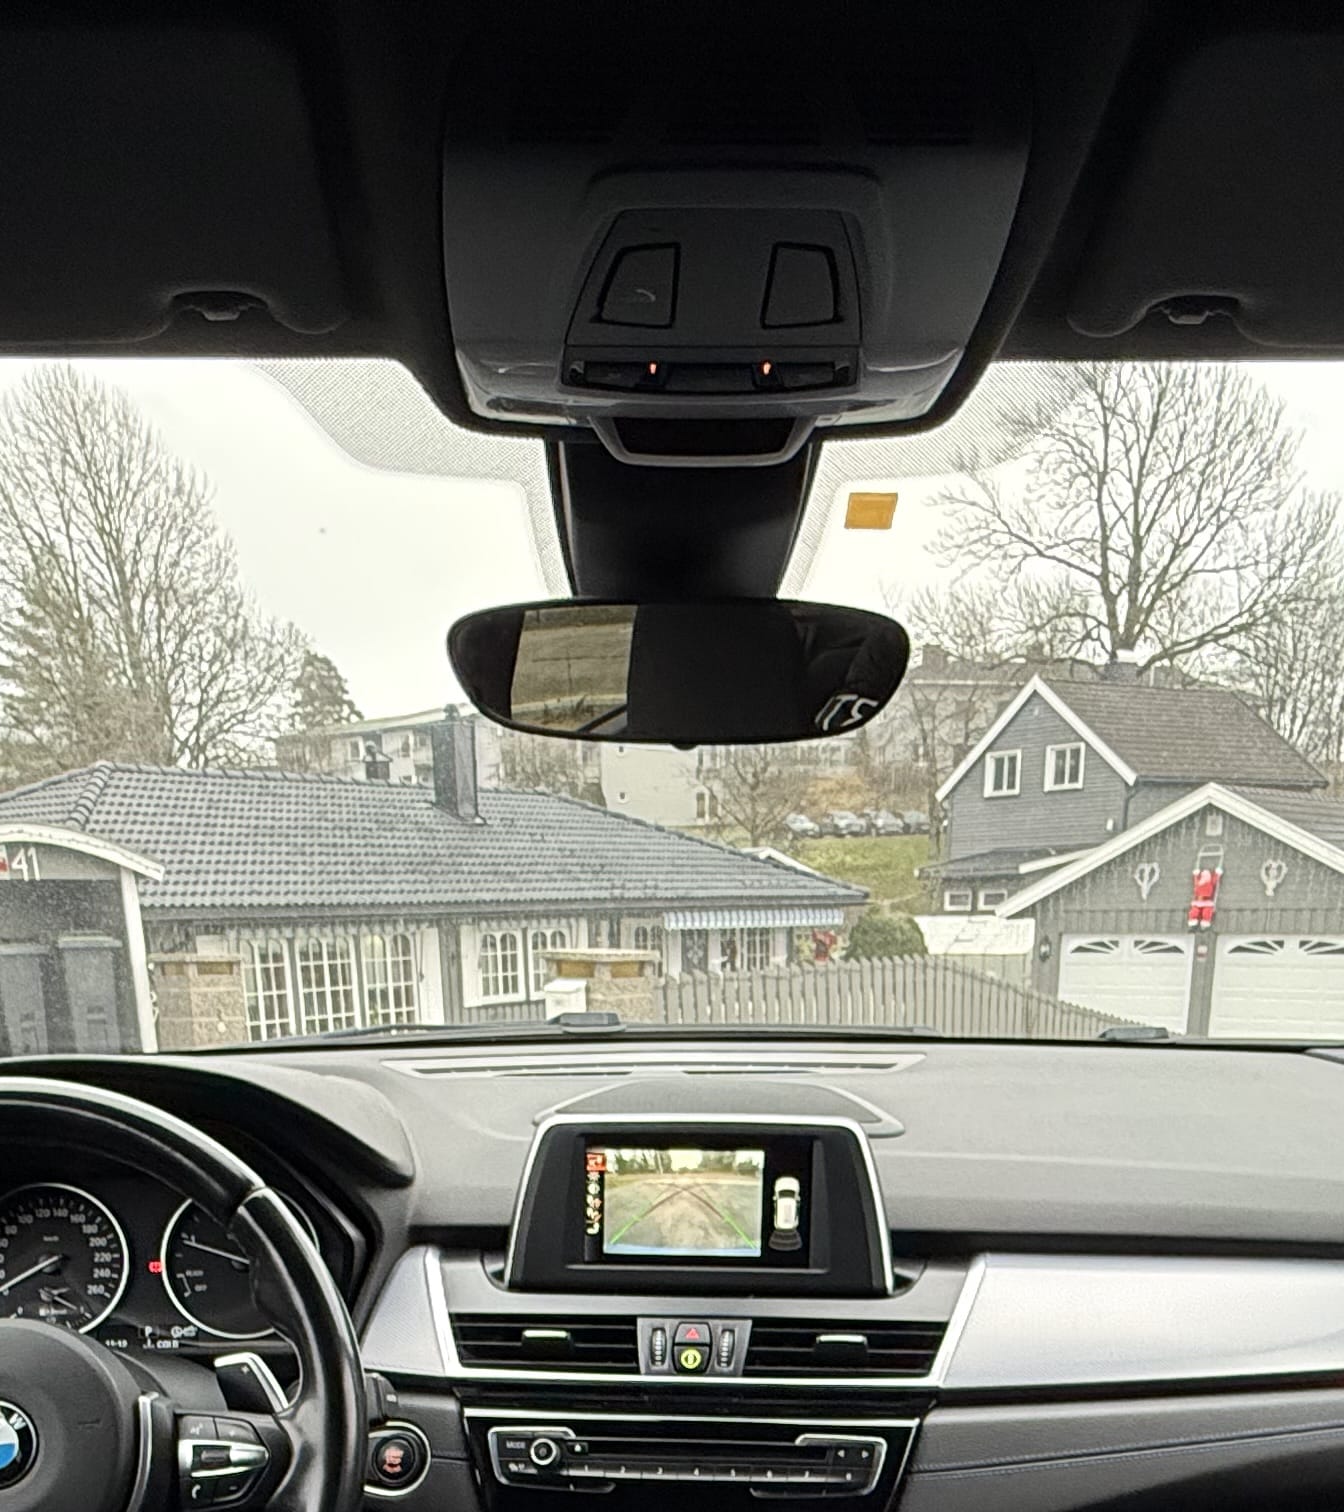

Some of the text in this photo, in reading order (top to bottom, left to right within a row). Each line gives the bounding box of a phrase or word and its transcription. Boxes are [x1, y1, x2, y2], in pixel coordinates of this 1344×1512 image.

[11, 847, 41, 882] 41
[70, 1213, 86, 1224] 160
[82, 1223, 98, 1234] 180
[89, 1237, 107, 1247] 200
[94, 1252, 112, 1262] 220
[93, 1268, 111, 1278] 240
[87, 1284, 105, 1295] 260
